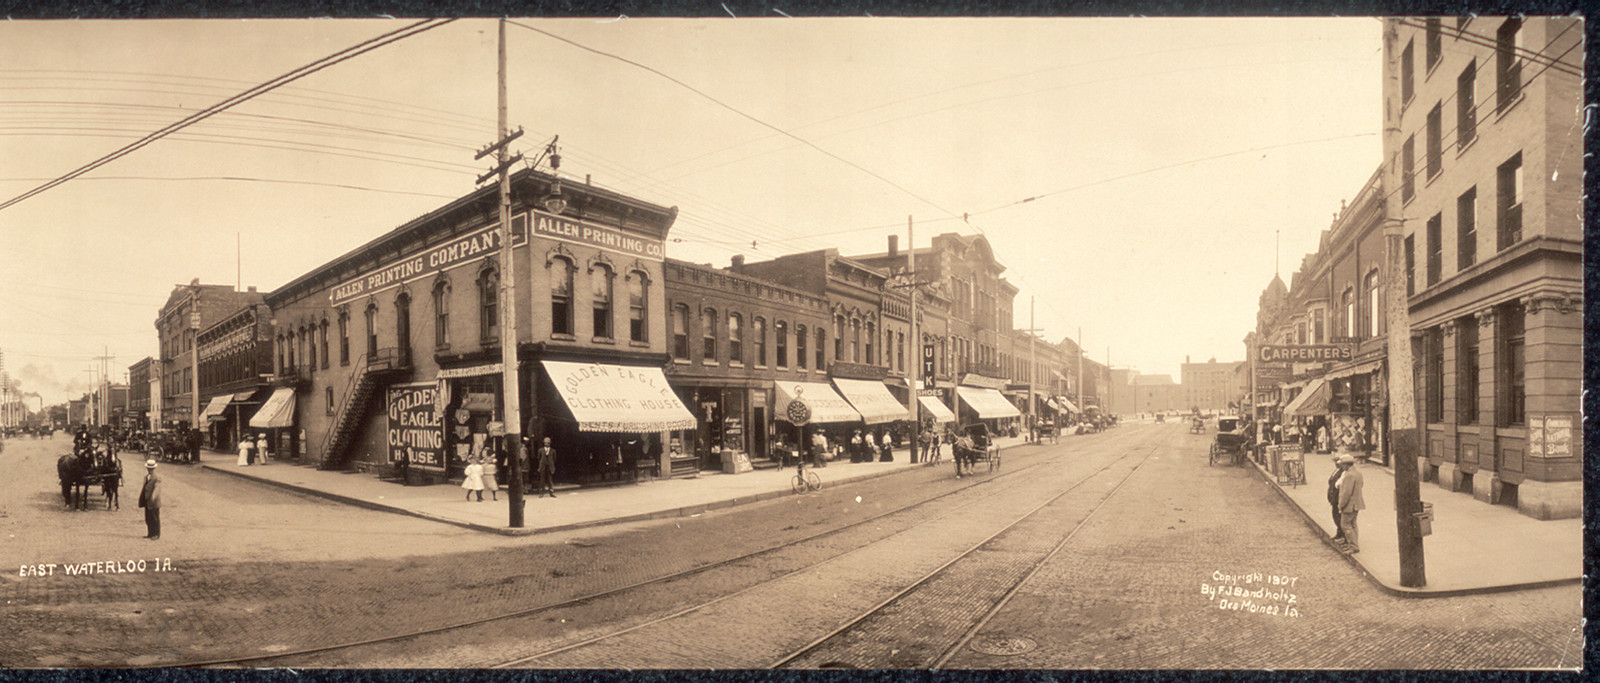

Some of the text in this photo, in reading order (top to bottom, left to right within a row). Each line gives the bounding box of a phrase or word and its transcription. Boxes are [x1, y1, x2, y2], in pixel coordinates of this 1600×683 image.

[538, 217, 662, 257] ALLEN PRINTING CO.
[335, 227, 504, 301] ALLEN PRINTING COMPANY
[1260, 346, 1351, 361] CARPENTERS
[565, 365, 669, 397] GOLDEN EAGLE
[389, 388, 437, 421] GOLDEN
[567, 397, 682, 410] CLOTHING HOUSE
[400, 411, 441, 428] EAGLE
[616, 421, 665, 430] FURNISHING
[666, 419, 693, 429] GOODS
[389, 429, 442, 449] CLOTHING
[394, 449, 438, 464] HUSE.
